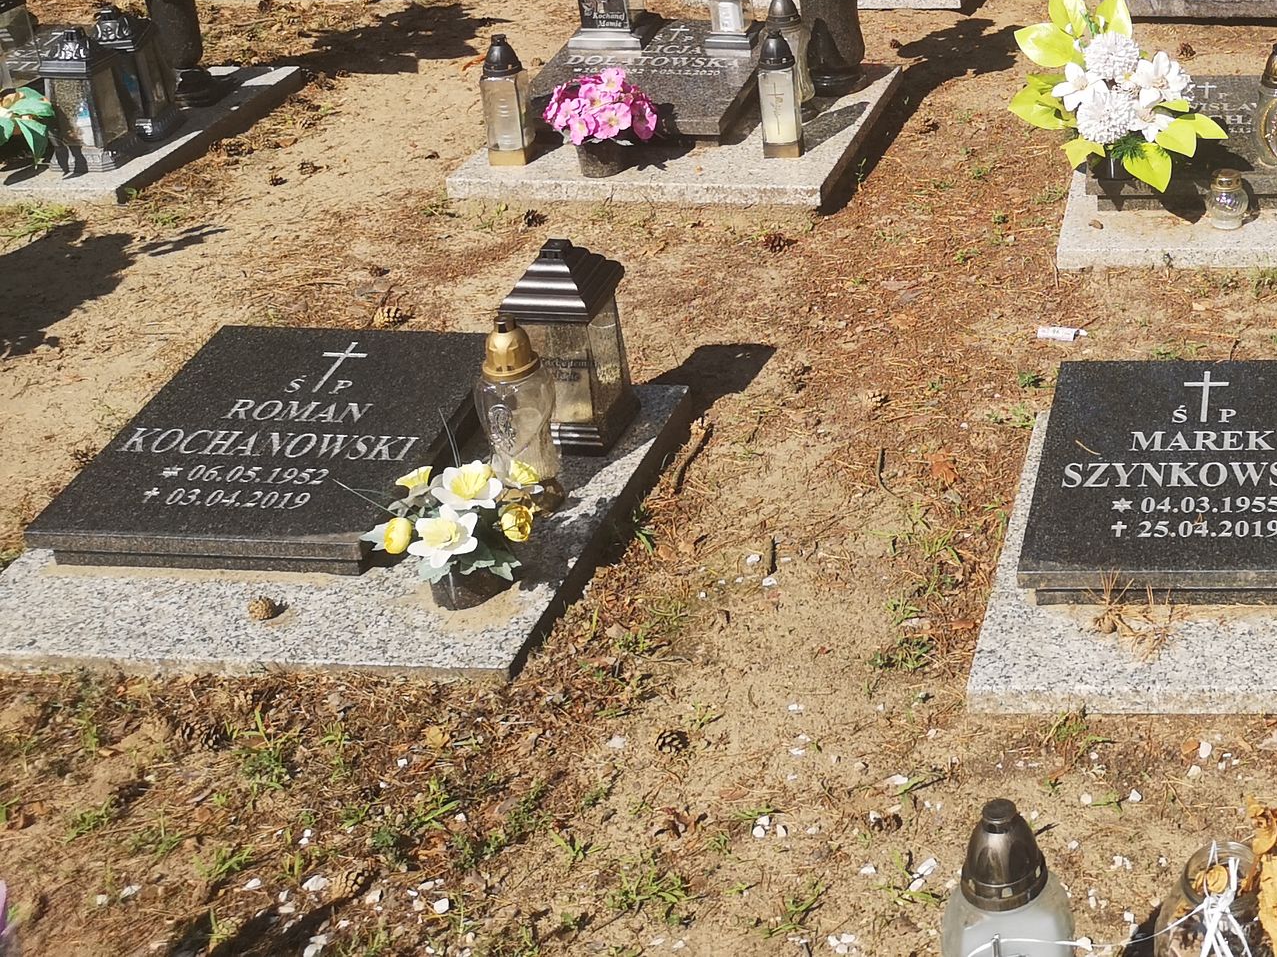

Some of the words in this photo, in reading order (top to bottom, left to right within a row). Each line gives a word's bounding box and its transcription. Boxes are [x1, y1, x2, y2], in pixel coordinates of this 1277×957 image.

[638, 44, 702, 55] LICJA
[284, 375, 307, 393] Ś
[328, 380, 353, 394] P
[221, 398, 374, 423] ROMAN
[1171, 405, 1188, 424] Ś
[1218, 408, 1237, 423] P
[116, 427, 420, 461] KOCHANOWSKI
[1128, 430, 1275, 452] MAREK
[187, 464, 330, 485] 06.05.1952
[165, 488, 311, 510] 03.04.2019
